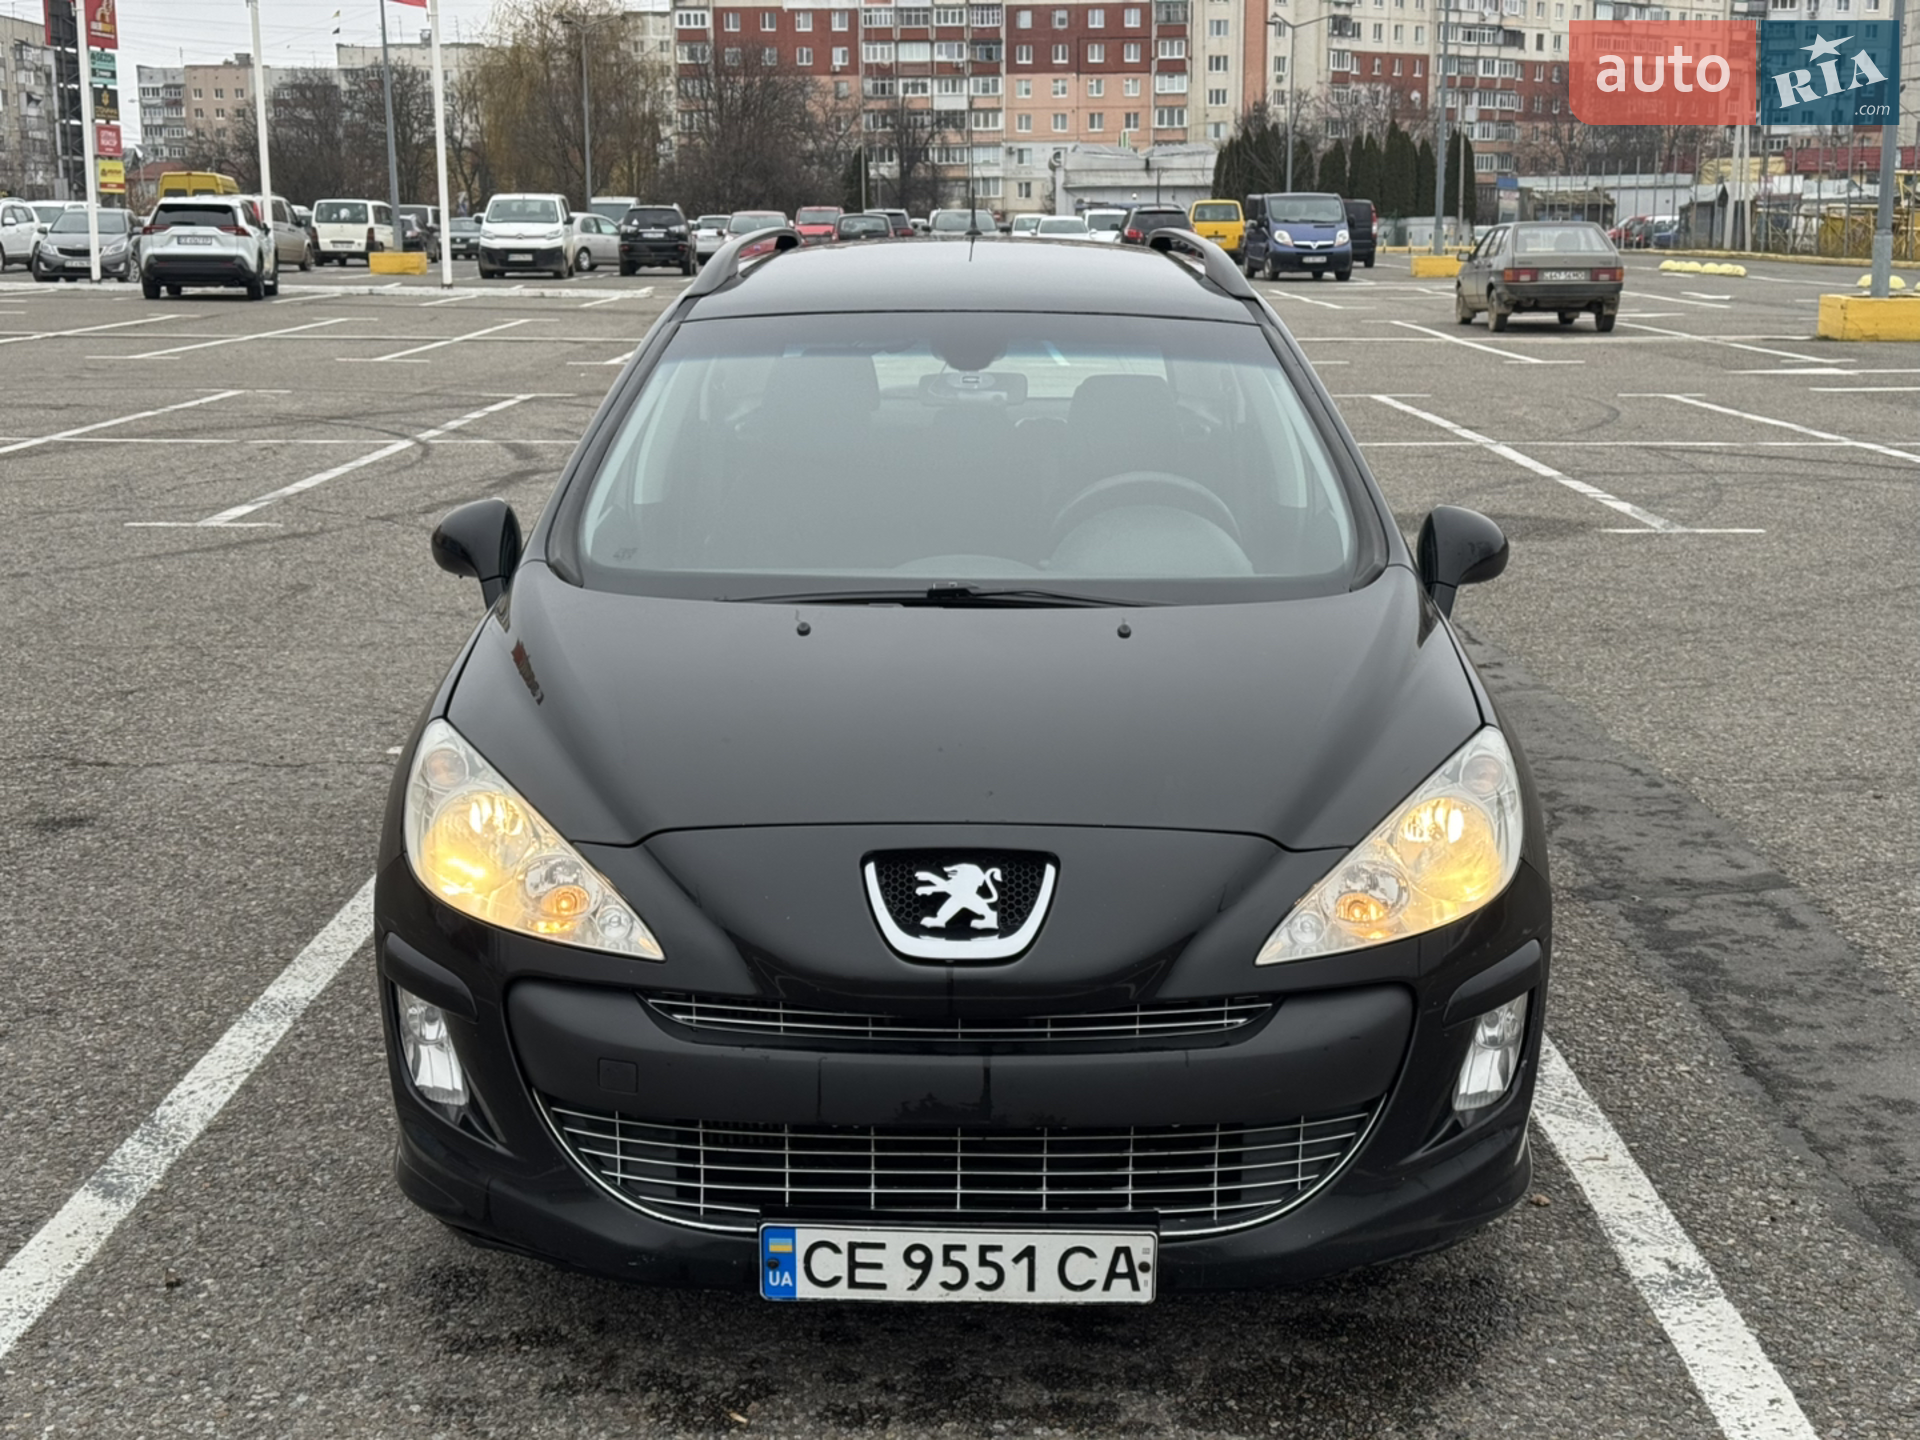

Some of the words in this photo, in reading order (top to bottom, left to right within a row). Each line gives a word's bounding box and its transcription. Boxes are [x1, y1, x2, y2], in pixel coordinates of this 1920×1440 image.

[768, 1270, 793, 1287] UA
[803, 1239, 888, 1291] CE
[902, 1243, 1036, 1293] 9551
[1057, 1245, 1141, 1293] CA
